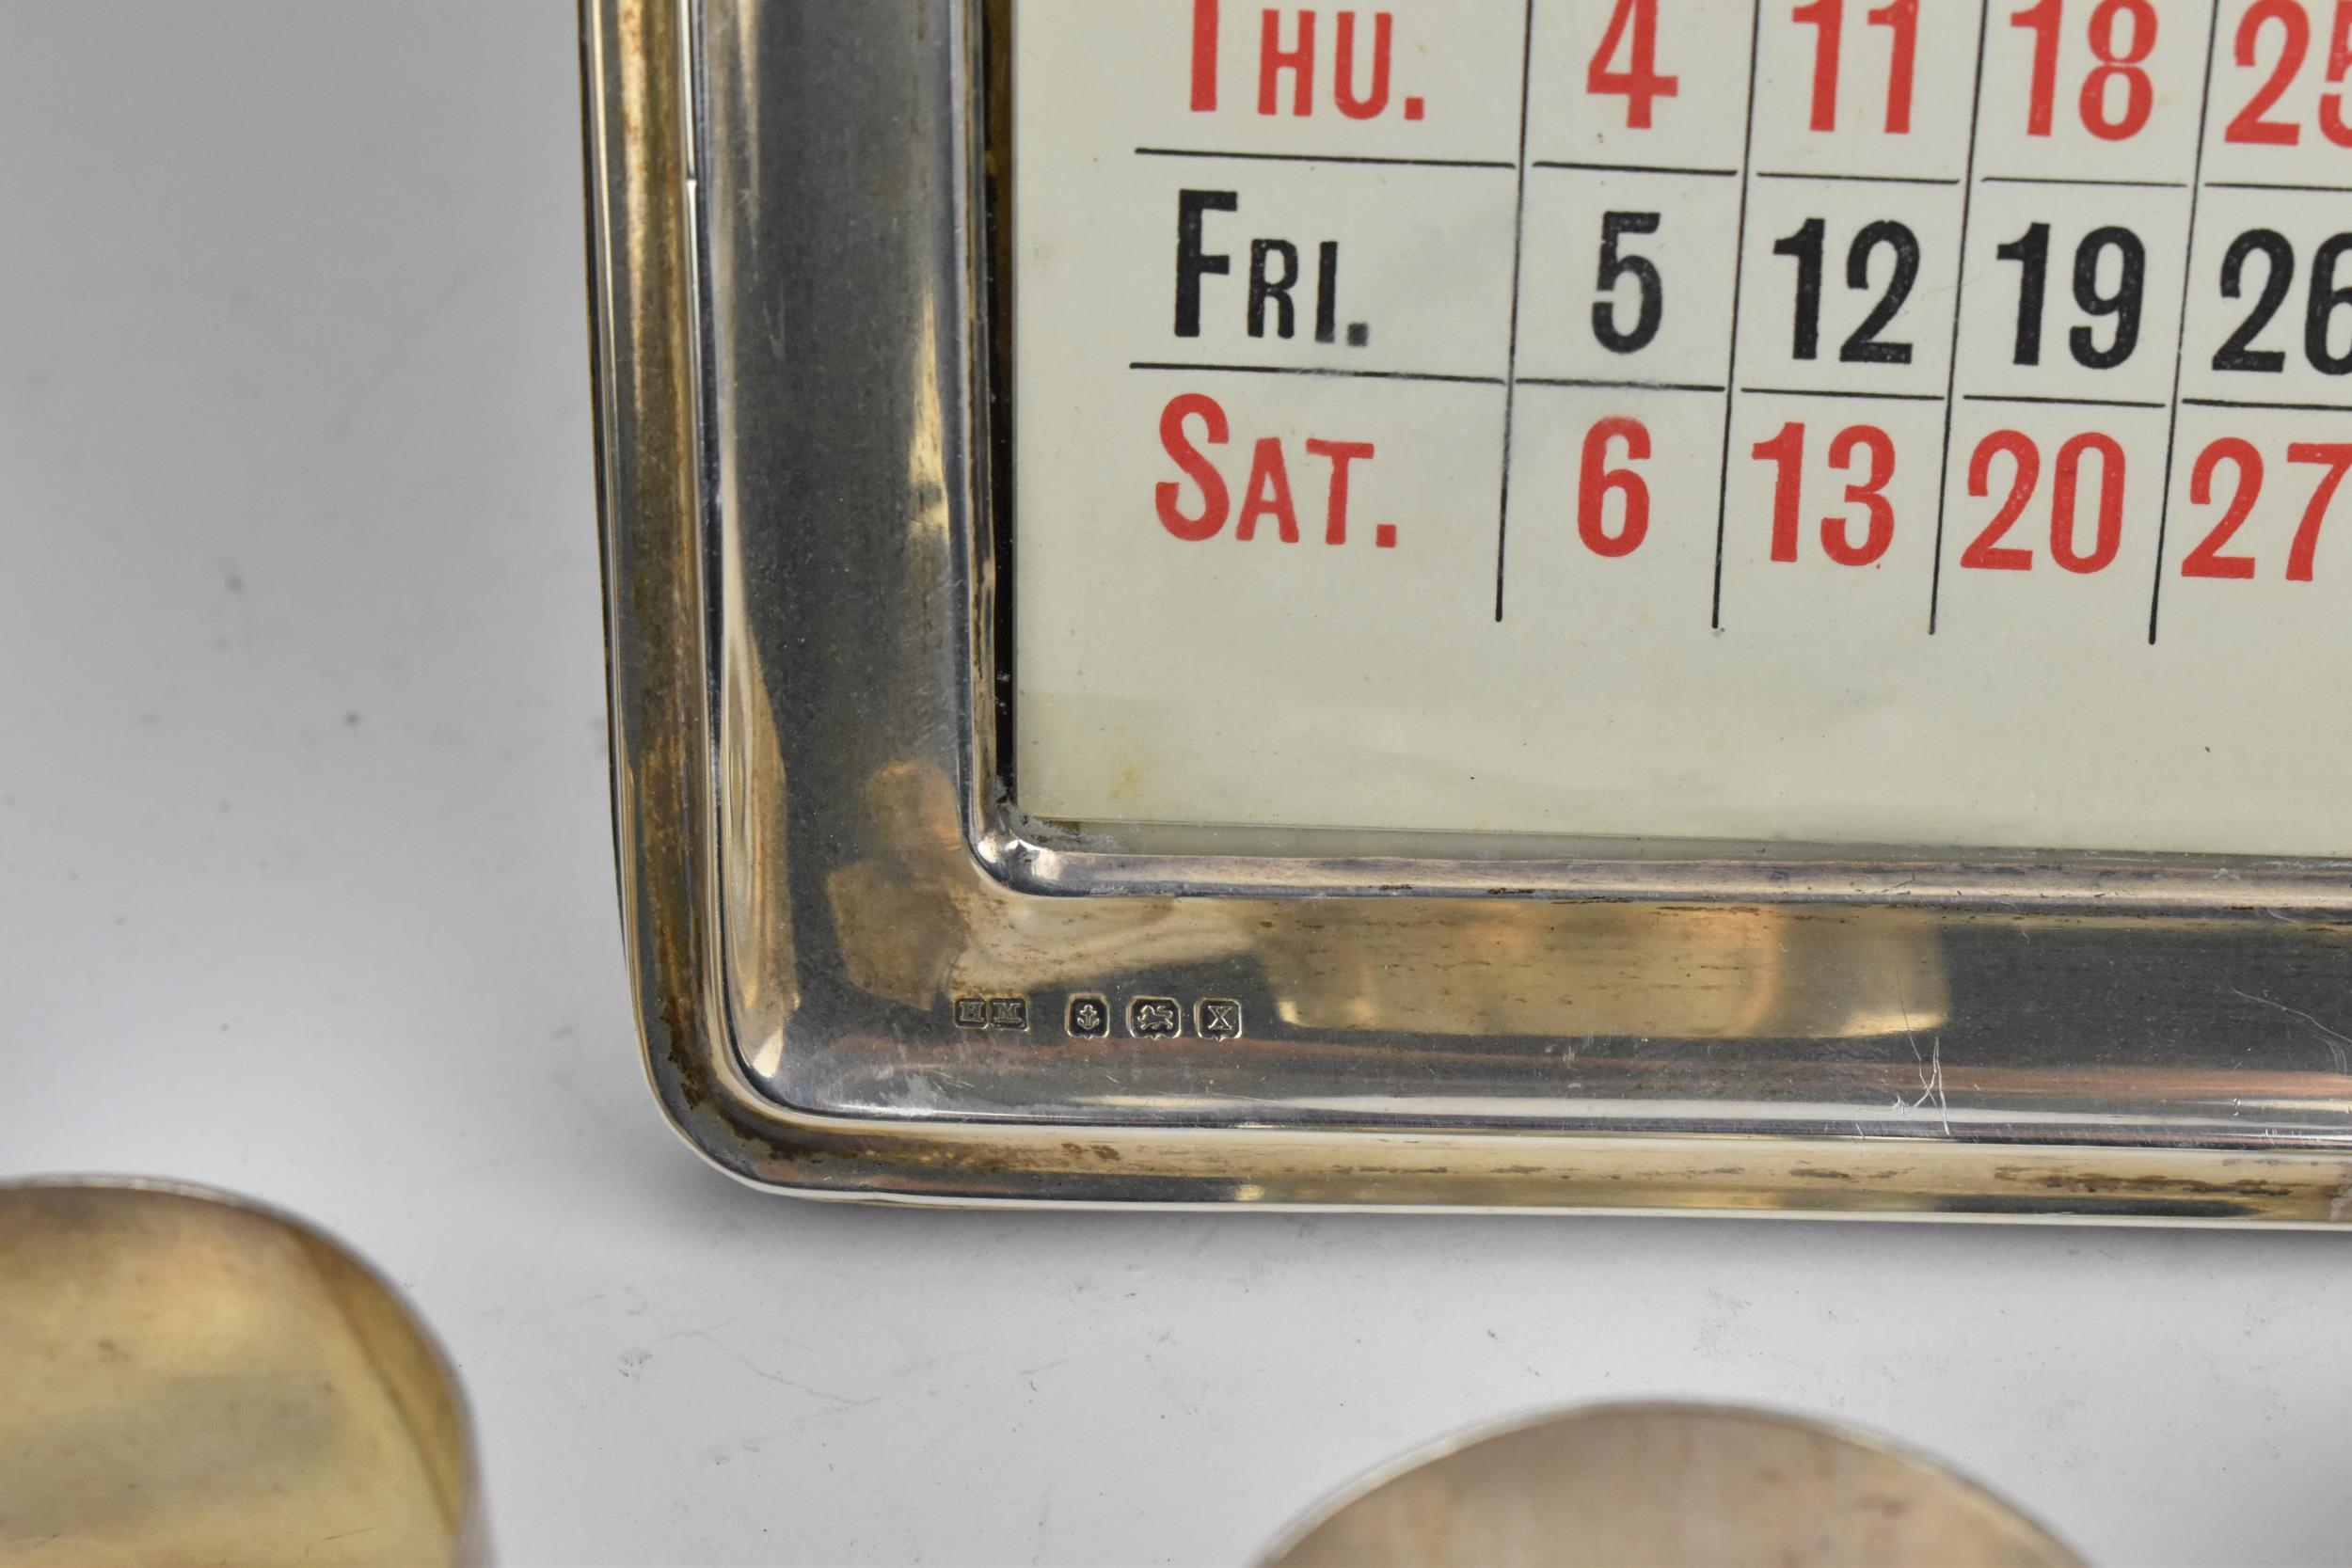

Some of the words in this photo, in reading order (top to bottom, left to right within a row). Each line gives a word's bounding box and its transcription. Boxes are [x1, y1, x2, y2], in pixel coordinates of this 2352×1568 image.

[1586, 0, 1678, 129] 4
[1792, 0, 1920, 135] 11
[2010, 0, 2158, 141] 18
[1173, 188, 1369, 348] FRI.
[1591, 211, 1662, 354] 5
[1772, 217, 1921, 365] 12
[1995, 222, 2146, 370] 19
[2212, 229, 2352, 375] 26
[1154, 392, 1397, 548] SAT.
[1577, 417, 1652, 558] 6
[1752, 421, 1896, 566] 13
[1960, 429, 2126, 575] 20
[2181, 436, 2352, 582] 27
